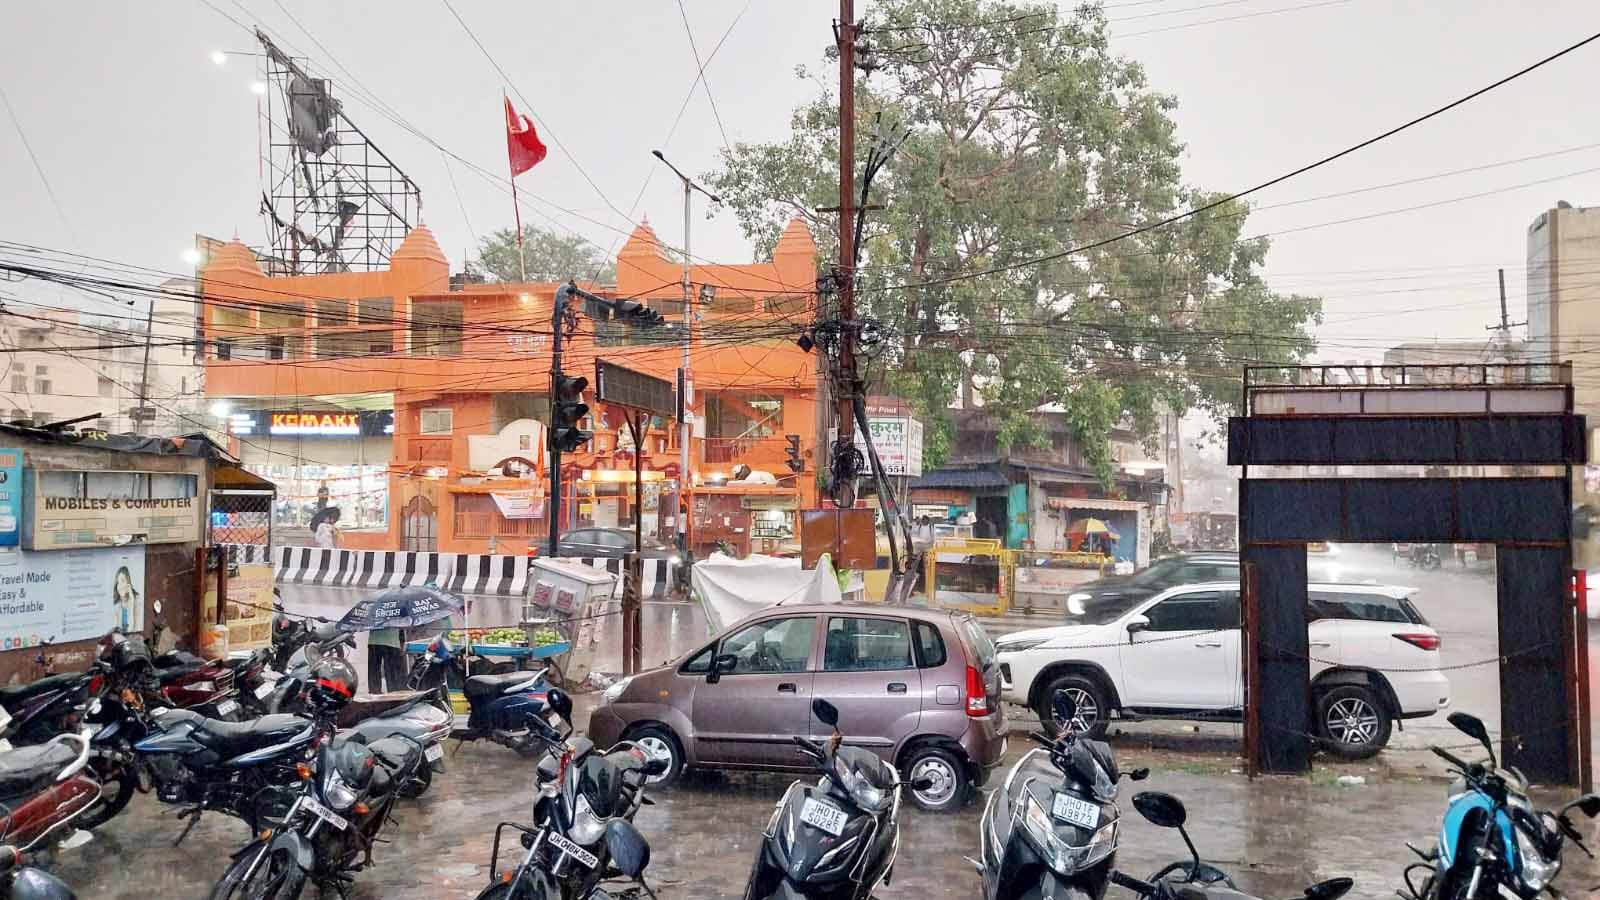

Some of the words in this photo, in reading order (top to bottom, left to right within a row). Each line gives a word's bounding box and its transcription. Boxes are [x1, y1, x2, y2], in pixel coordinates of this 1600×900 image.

[273, 413, 358, 427] KEMAKI
[45, 497, 108, 510] MOBILES
[111, 498, 122, 509] &
[125, 497, 192, 509] COMPUTER
[27, 571, 51, 584] Made
[19, 588, 26, 599] &
[411, 602, 439, 615] NIWAS
[414, 598, 431, 608] RAJ
[811, 803, 842, 822] JH01E
[808, 812, 839, 832] S0285
